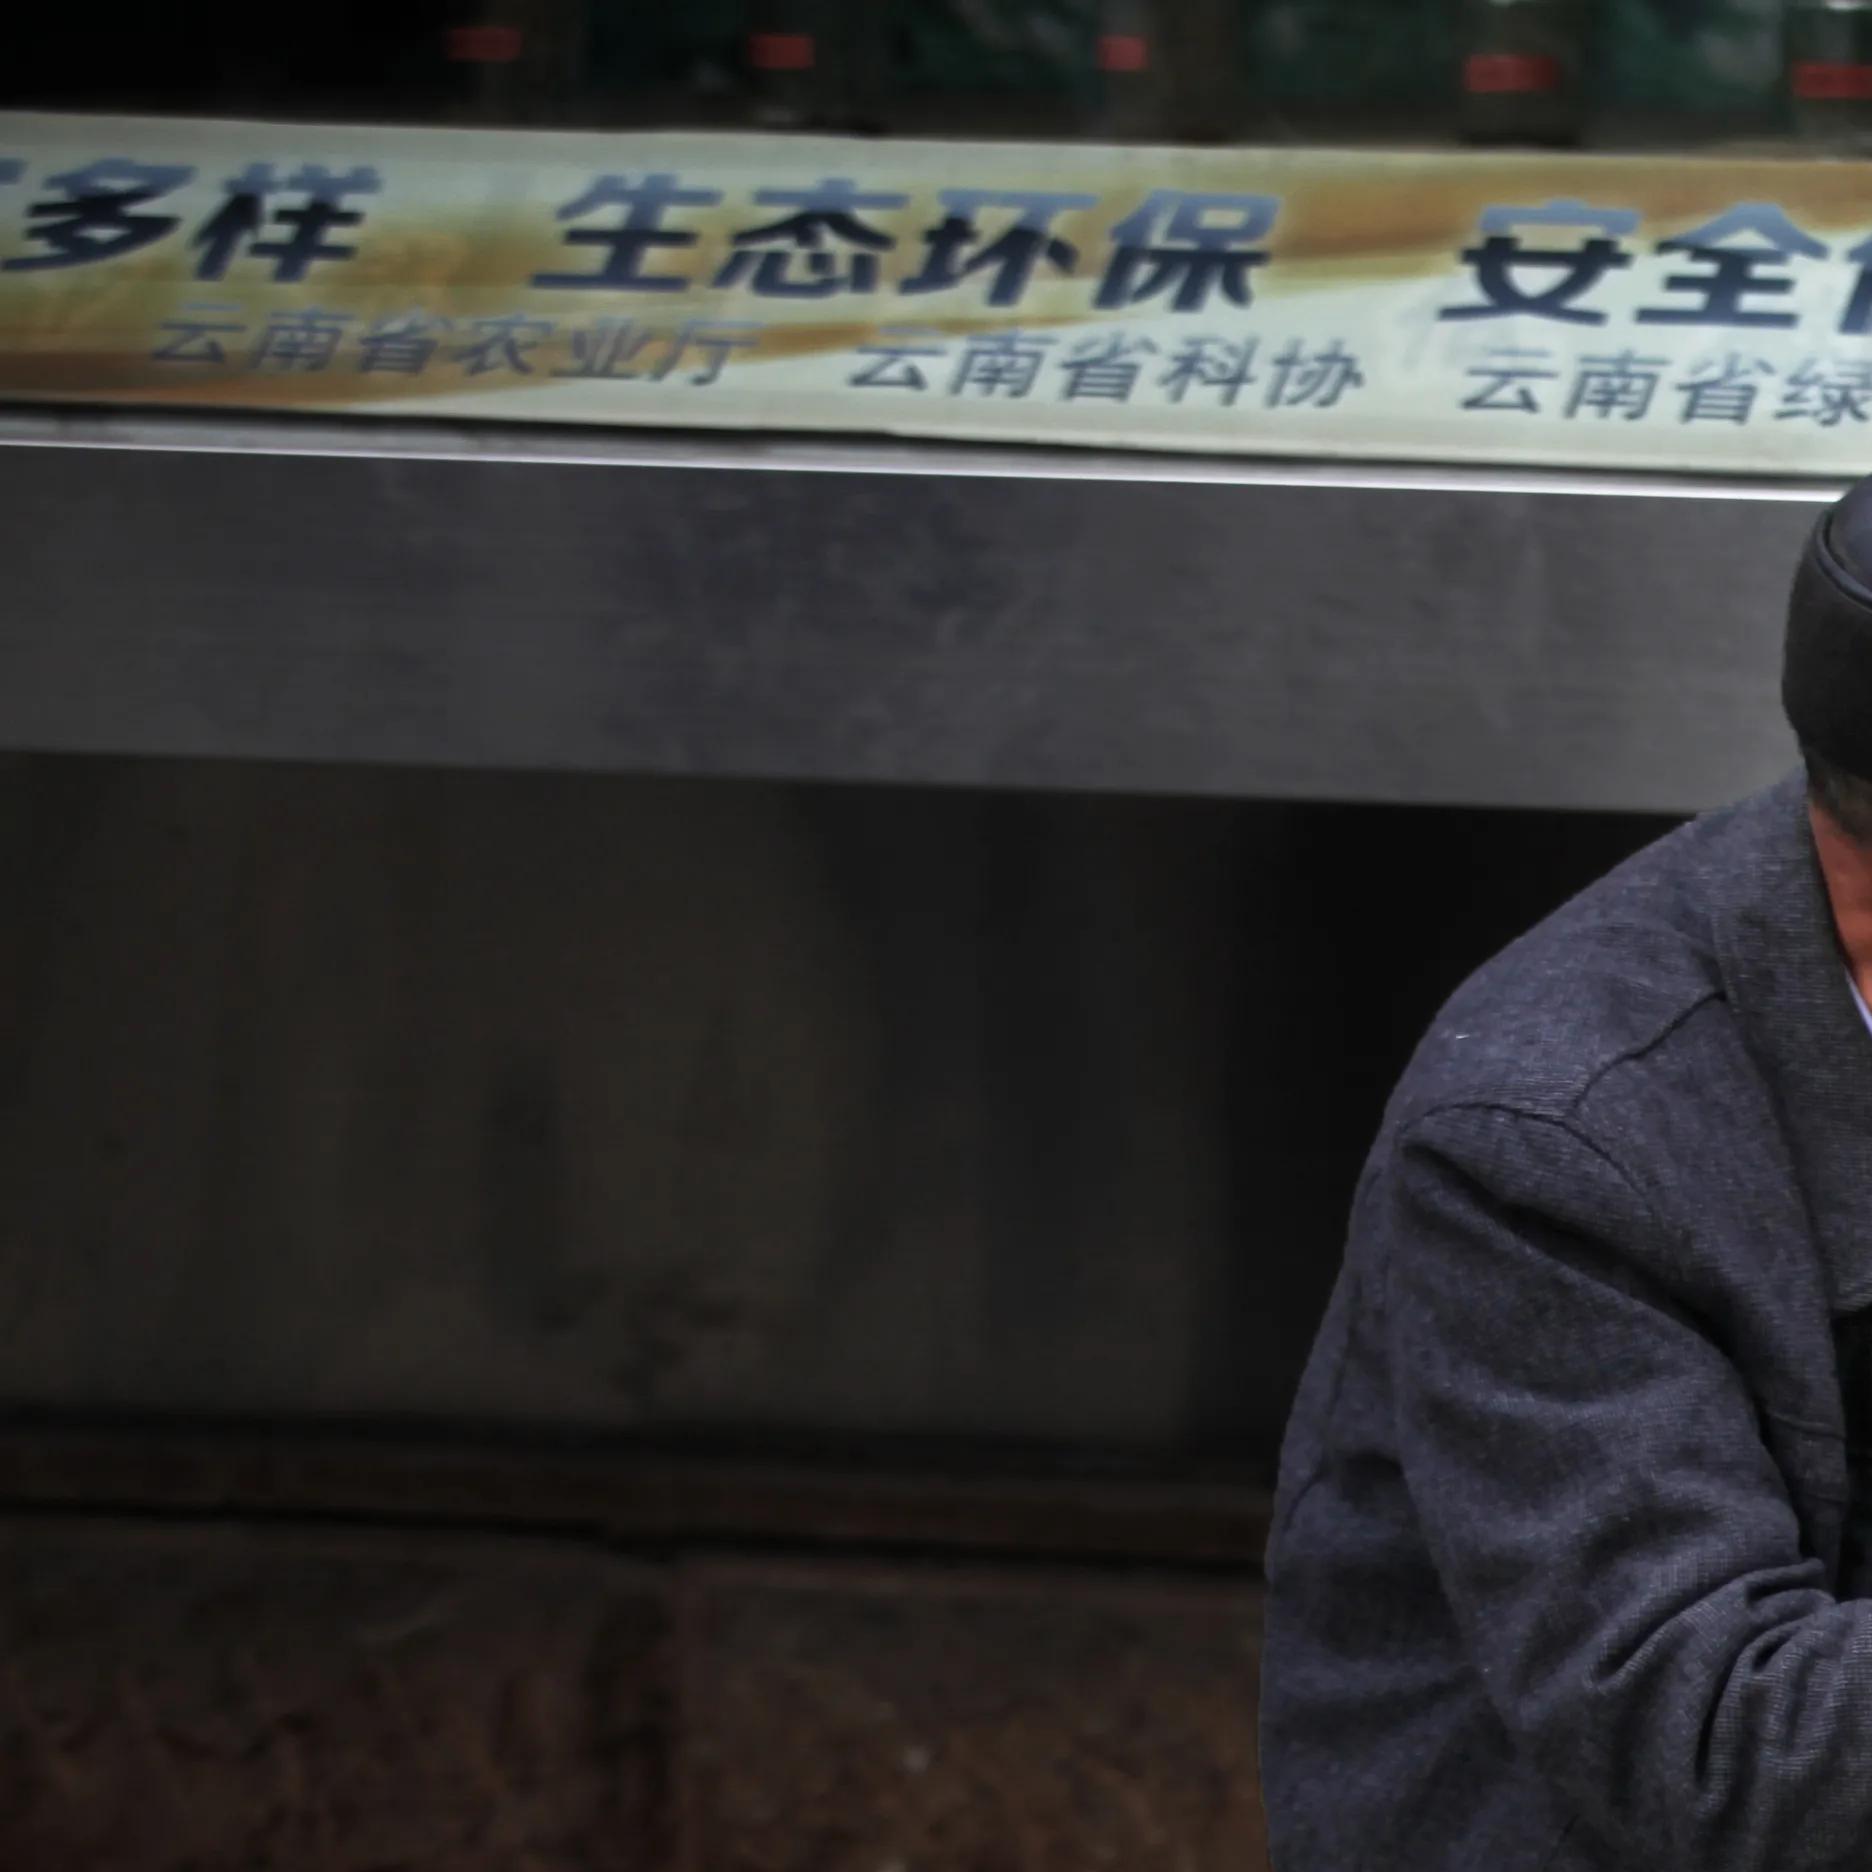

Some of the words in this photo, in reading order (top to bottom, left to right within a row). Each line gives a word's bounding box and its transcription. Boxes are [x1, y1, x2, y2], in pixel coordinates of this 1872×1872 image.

[0, 157, 386, 282] 多样
[530, 173, 1284, 312] 生态环保
[151, 302, 765, 387] 云南省农业厅
[846, 325, 1366, 410] 云南省科协
